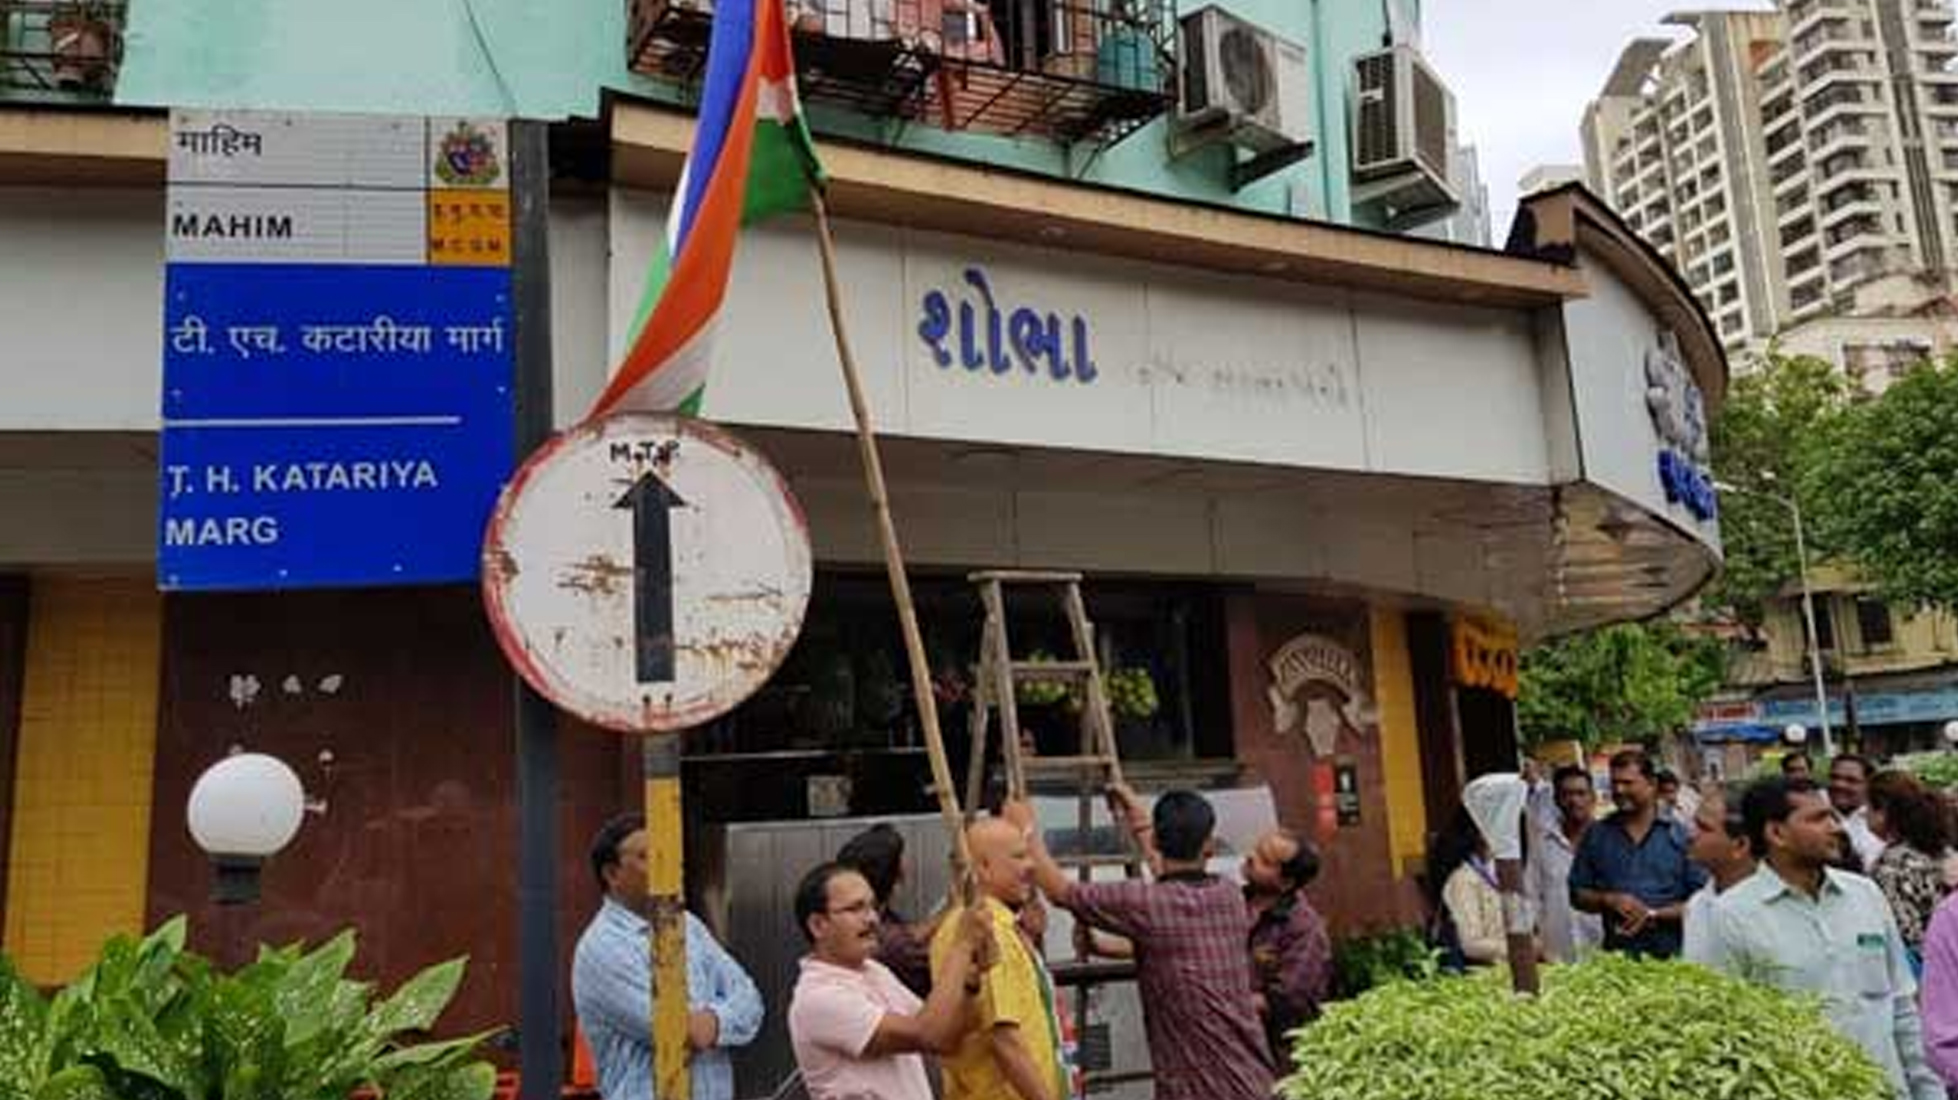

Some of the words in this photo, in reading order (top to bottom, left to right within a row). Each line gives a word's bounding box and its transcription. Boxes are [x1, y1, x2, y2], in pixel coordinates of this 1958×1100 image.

[176, 123, 262, 157] माहिम
[172, 214, 293, 239] MAHIM
[171, 316, 215, 354] टी.
[229, 327, 287, 358] एच.
[301, 314, 432, 354] कटारीया
[444, 317, 504, 354] मार्ग
[917, 268, 1099, 384] શોભા
[167, 465, 195, 495] T.
[206, 465, 240, 494] H.
[252, 460, 439, 493] KATARIYA
[164, 516, 280, 547] MARG
